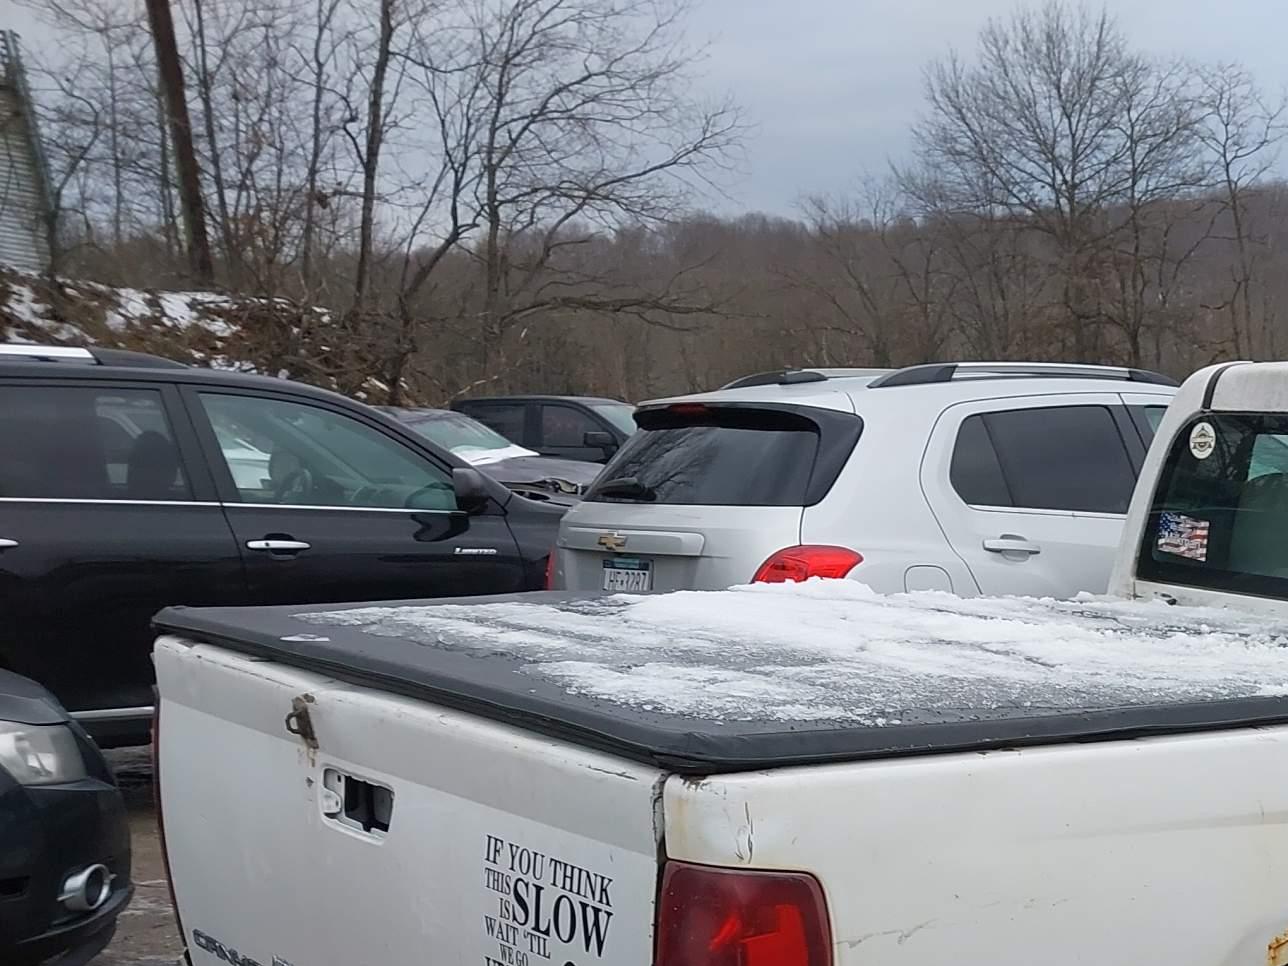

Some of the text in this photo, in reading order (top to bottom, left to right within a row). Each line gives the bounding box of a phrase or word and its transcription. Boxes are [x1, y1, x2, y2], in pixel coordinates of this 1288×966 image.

[485, 834, 613, 908] IF YOU THINK
[485, 867, 511, 895] THIS
[499, 897, 511, 920] IS
[512, 878, 614, 958] SLOW
[484, 915, 518, 947] WAIT
[499, 943, 514, 966] WE
